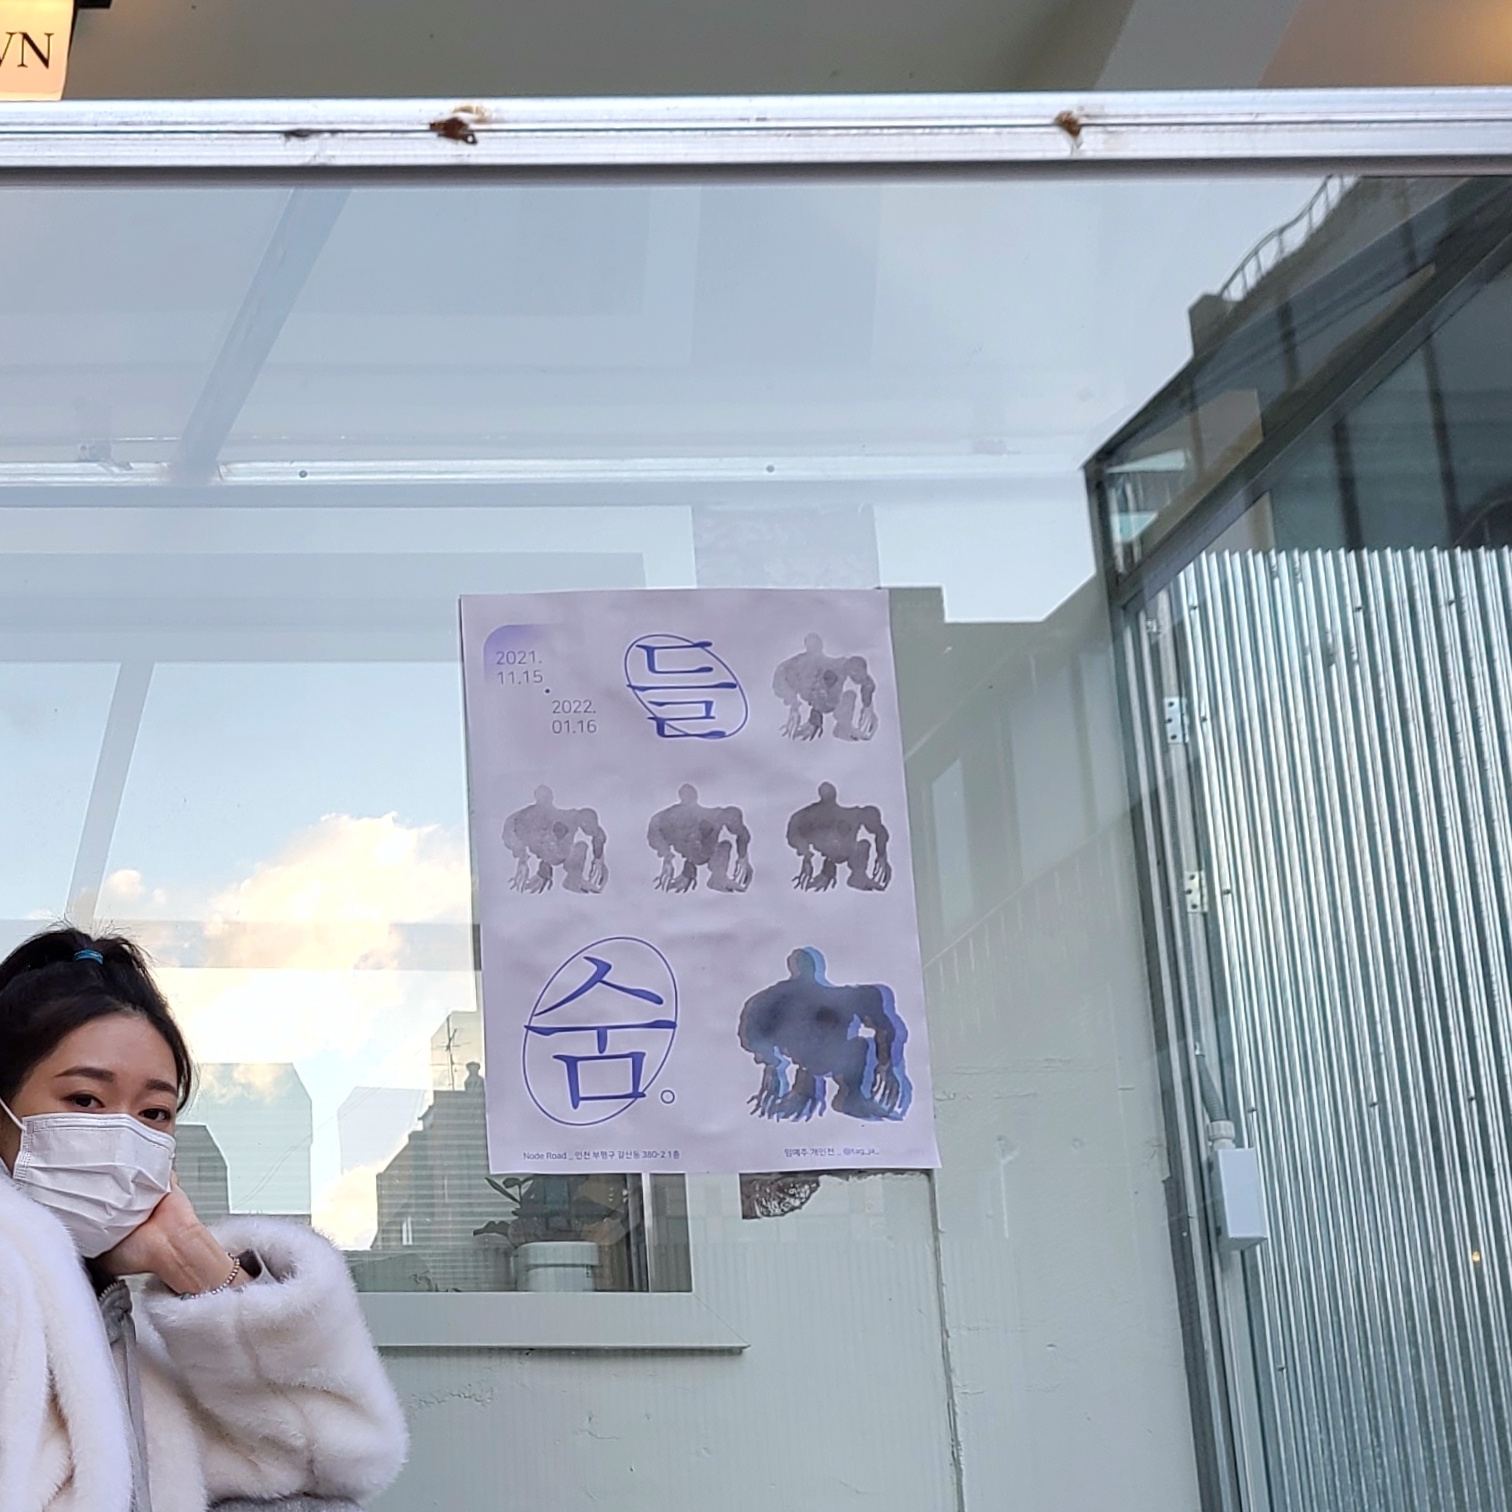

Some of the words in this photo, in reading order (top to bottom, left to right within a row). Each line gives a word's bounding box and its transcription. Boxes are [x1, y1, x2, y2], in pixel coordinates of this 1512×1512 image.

[496, 650, 543, 666] 2021.
[496, 669, 544, 686] 11.15
[626, 640, 738, 739] 들
[551, 699, 598, 715] 2022.
[551, 719, 598, 735] 01.16
[523, 1152, 545, 1160] Node
[546, 1152, 567, 1160] Road
[574, 1151, 591, 1161] 인천
[593, 1150, 616, 1160] 부평구
